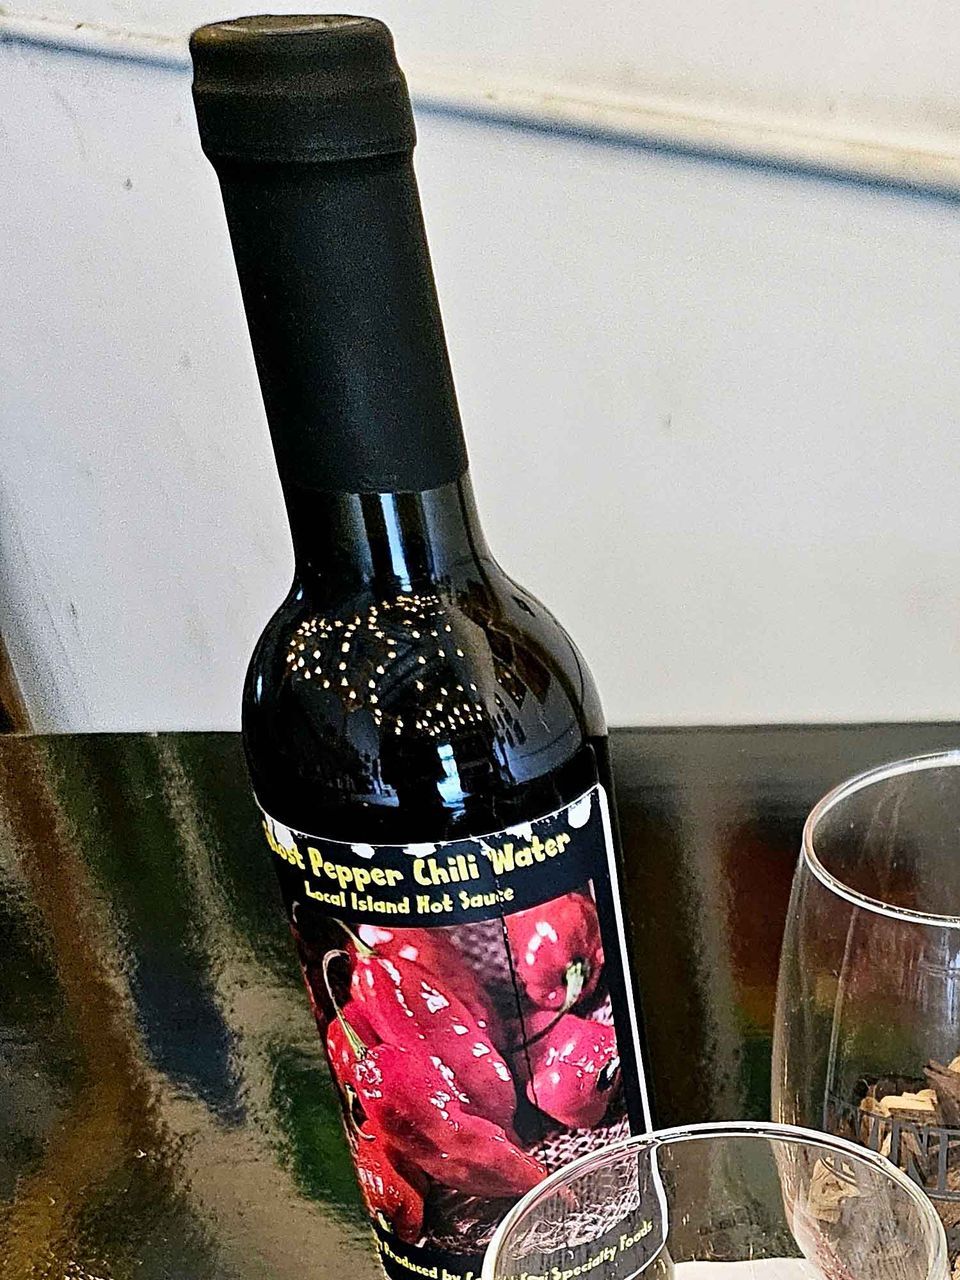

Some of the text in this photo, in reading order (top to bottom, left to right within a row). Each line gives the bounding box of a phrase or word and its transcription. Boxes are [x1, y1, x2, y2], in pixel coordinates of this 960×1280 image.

[308, 847, 404, 891] Pepper
[413, 855, 479, 886] Chili
[486, 832, 571, 875] Water
[304, 881, 514, 914] Local Island Hot Sauce
[620, 1220, 653, 1252] Foods
[384, 1242, 437, 1278] Produced
